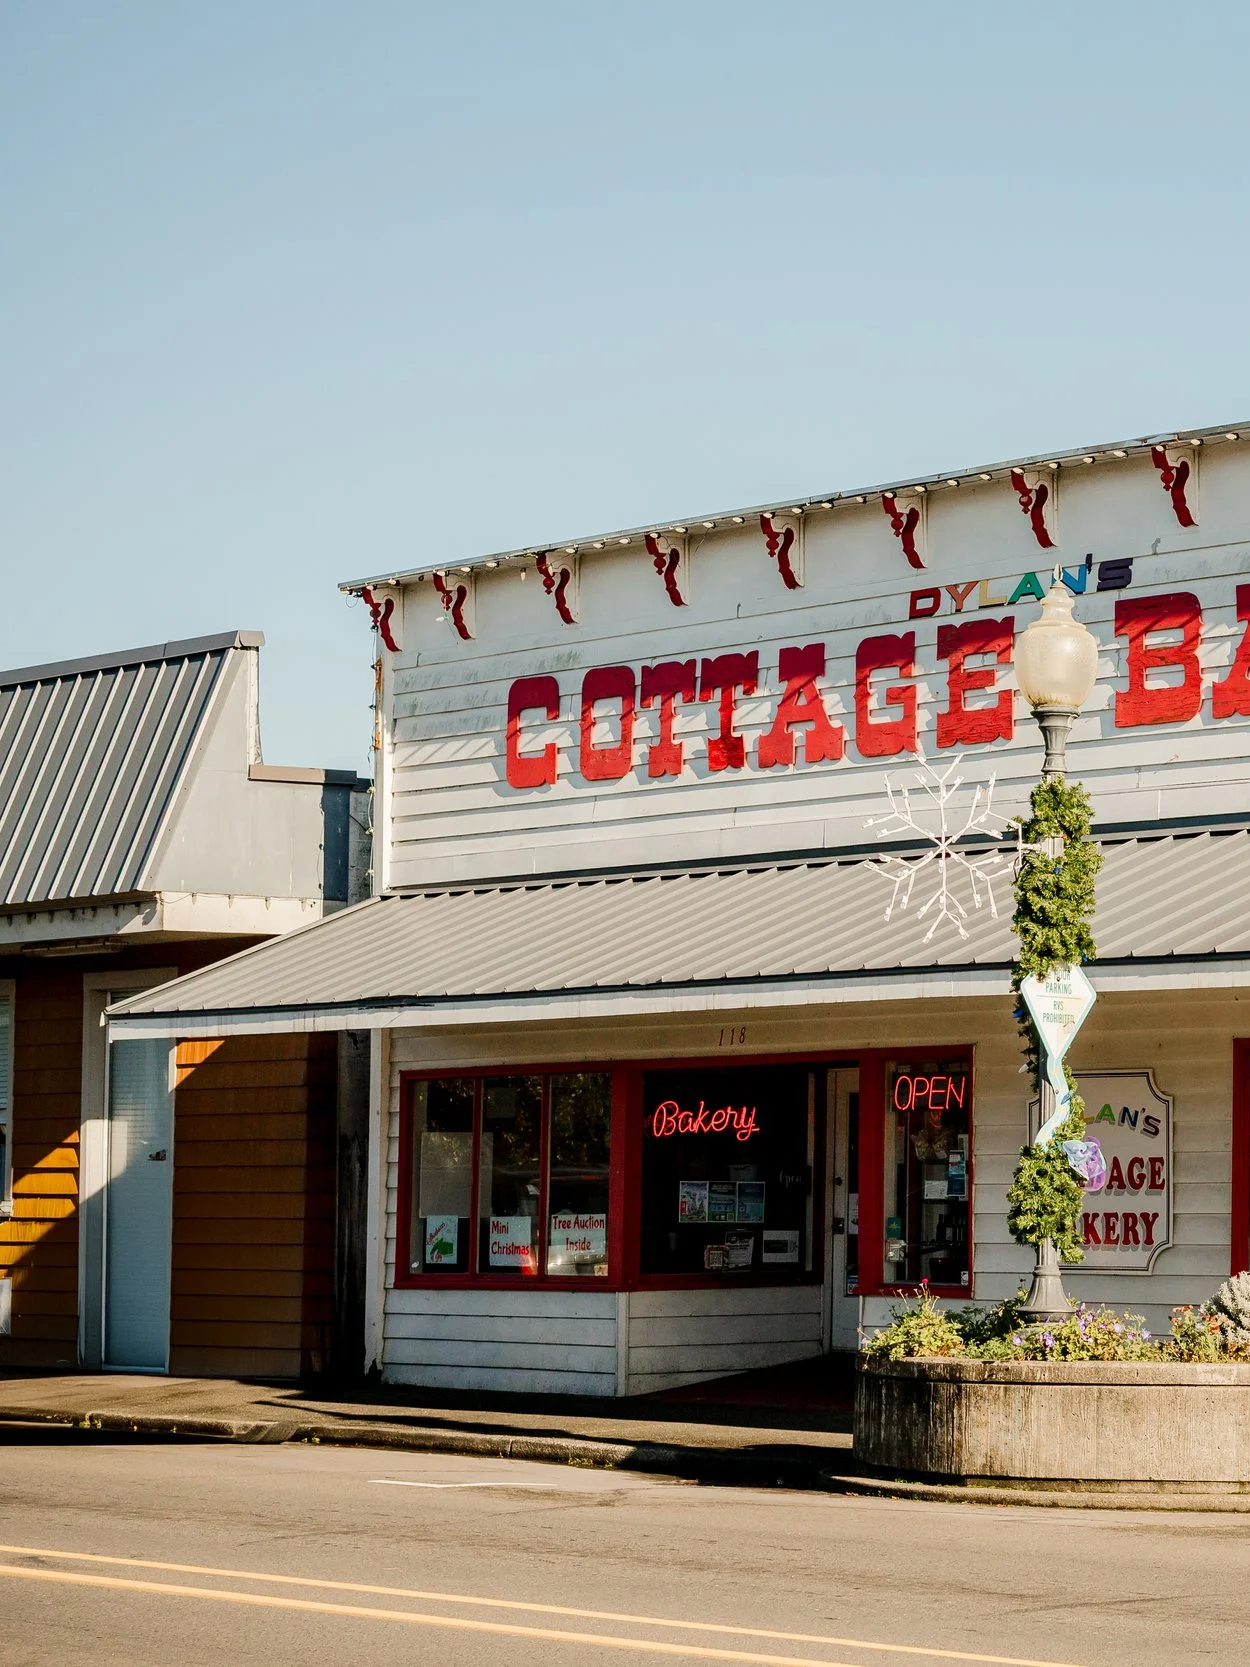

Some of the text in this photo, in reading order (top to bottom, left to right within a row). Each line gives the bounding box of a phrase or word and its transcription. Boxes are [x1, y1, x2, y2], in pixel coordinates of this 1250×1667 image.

[908, 554, 1133, 618] DYLAN'S
[506, 616, 1014, 789] COTTAGE
[1045, 982, 1073, 995] PARKING
[718, 1026, 747, 1047] 118
[894, 1075, 966, 1111] OPEN
[652, 1100, 760, 1141] Bakery
[491, 1220, 509, 1234] Mini
[552, 1215, 605, 1230] Tree Auction
[1073, 1212, 1159, 1246] KERY
[491, 1241, 530, 1256] Christmas
[565, 1237, 591, 1251] Inside
